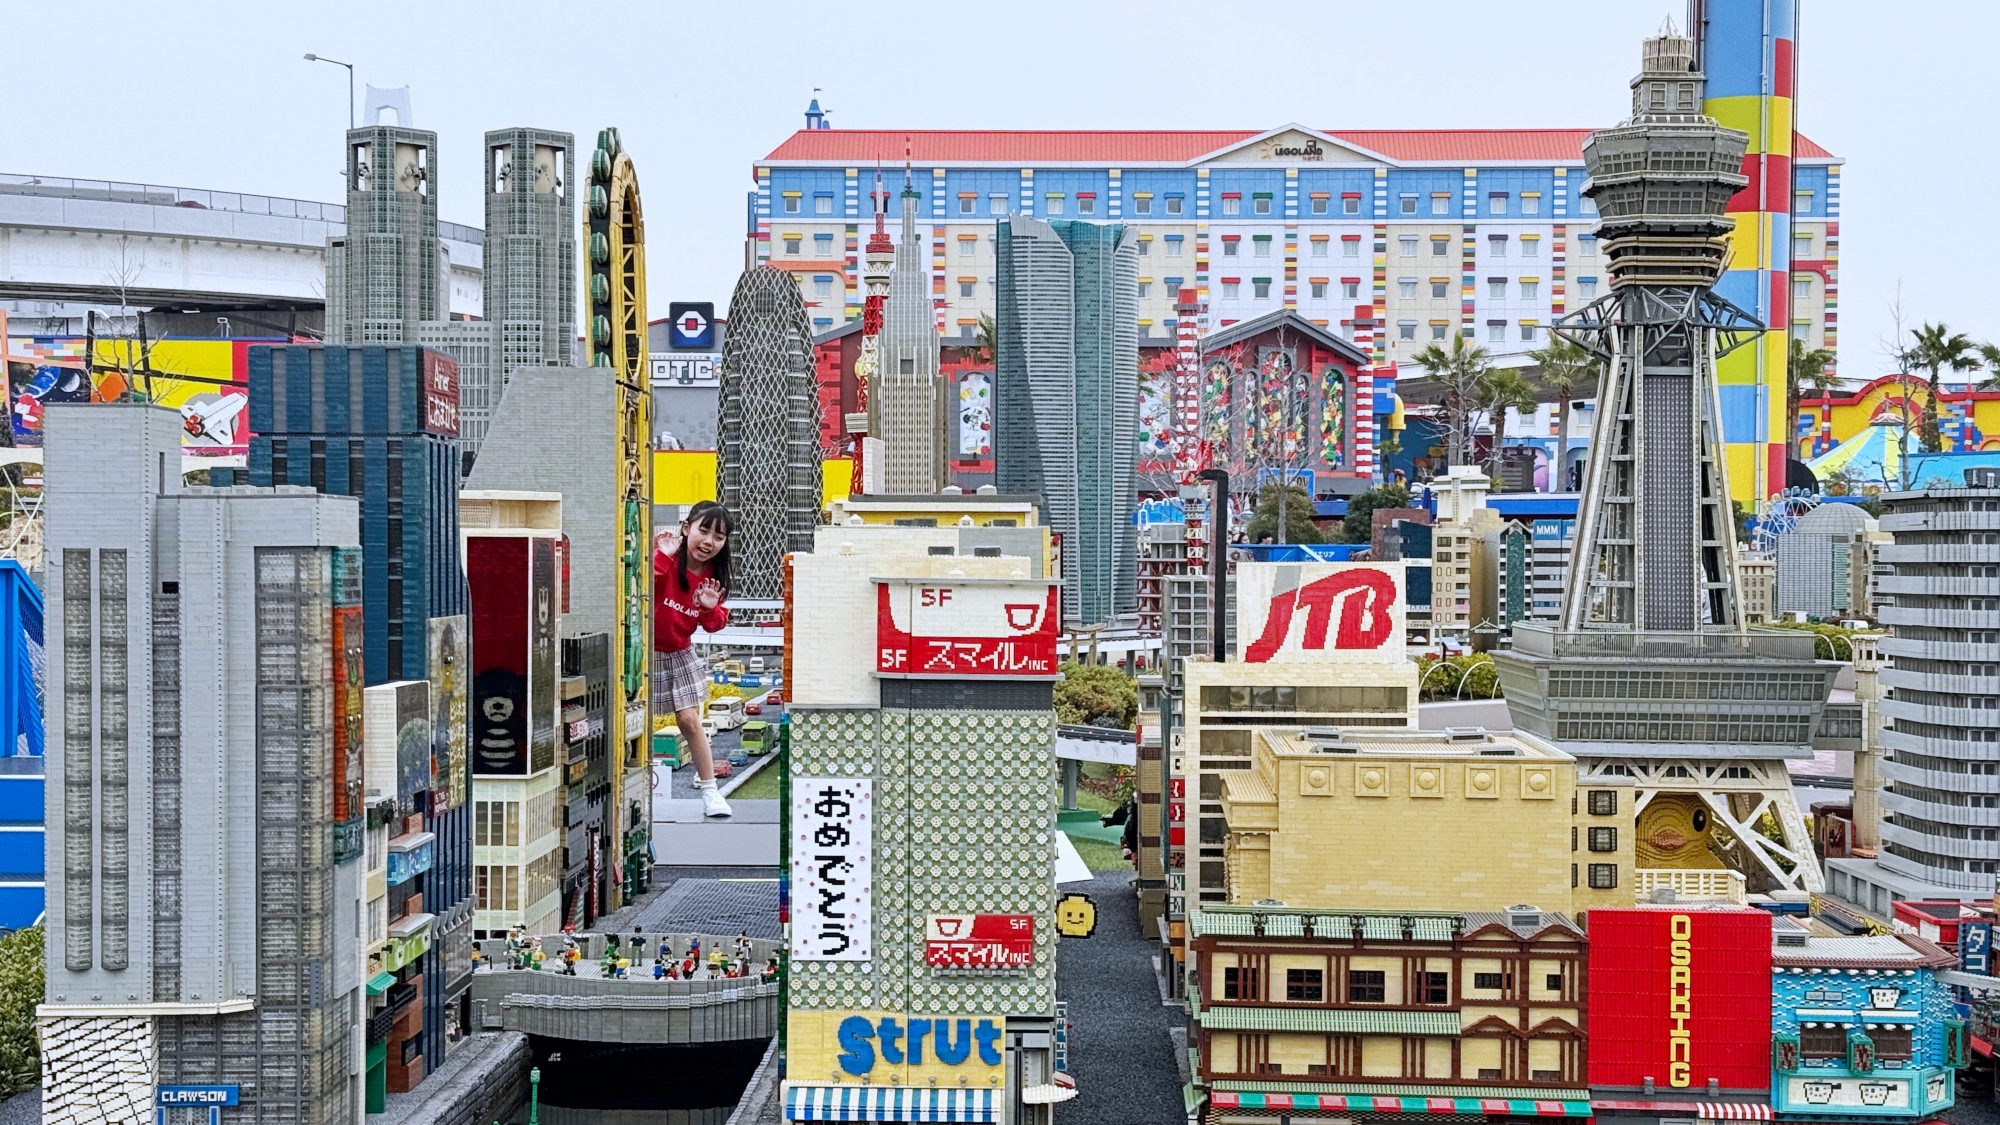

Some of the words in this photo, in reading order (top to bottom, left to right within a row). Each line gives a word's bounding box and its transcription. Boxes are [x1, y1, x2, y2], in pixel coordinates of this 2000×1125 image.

[1275, 147, 1323, 156] LEGOLAND
[649, 360, 714, 379] OTIC
[1536, 524, 1559, 536] MMM
[921, 588, 953, 607] 5F
[1244, 568, 1397, 664] JTB
[882, 648, 907, 669] 5F
[814, 785, 854, 955] おめでとう
[837, 1015, 1002, 1076] Strut
[161, 1090, 227, 1102] CLAWSON
